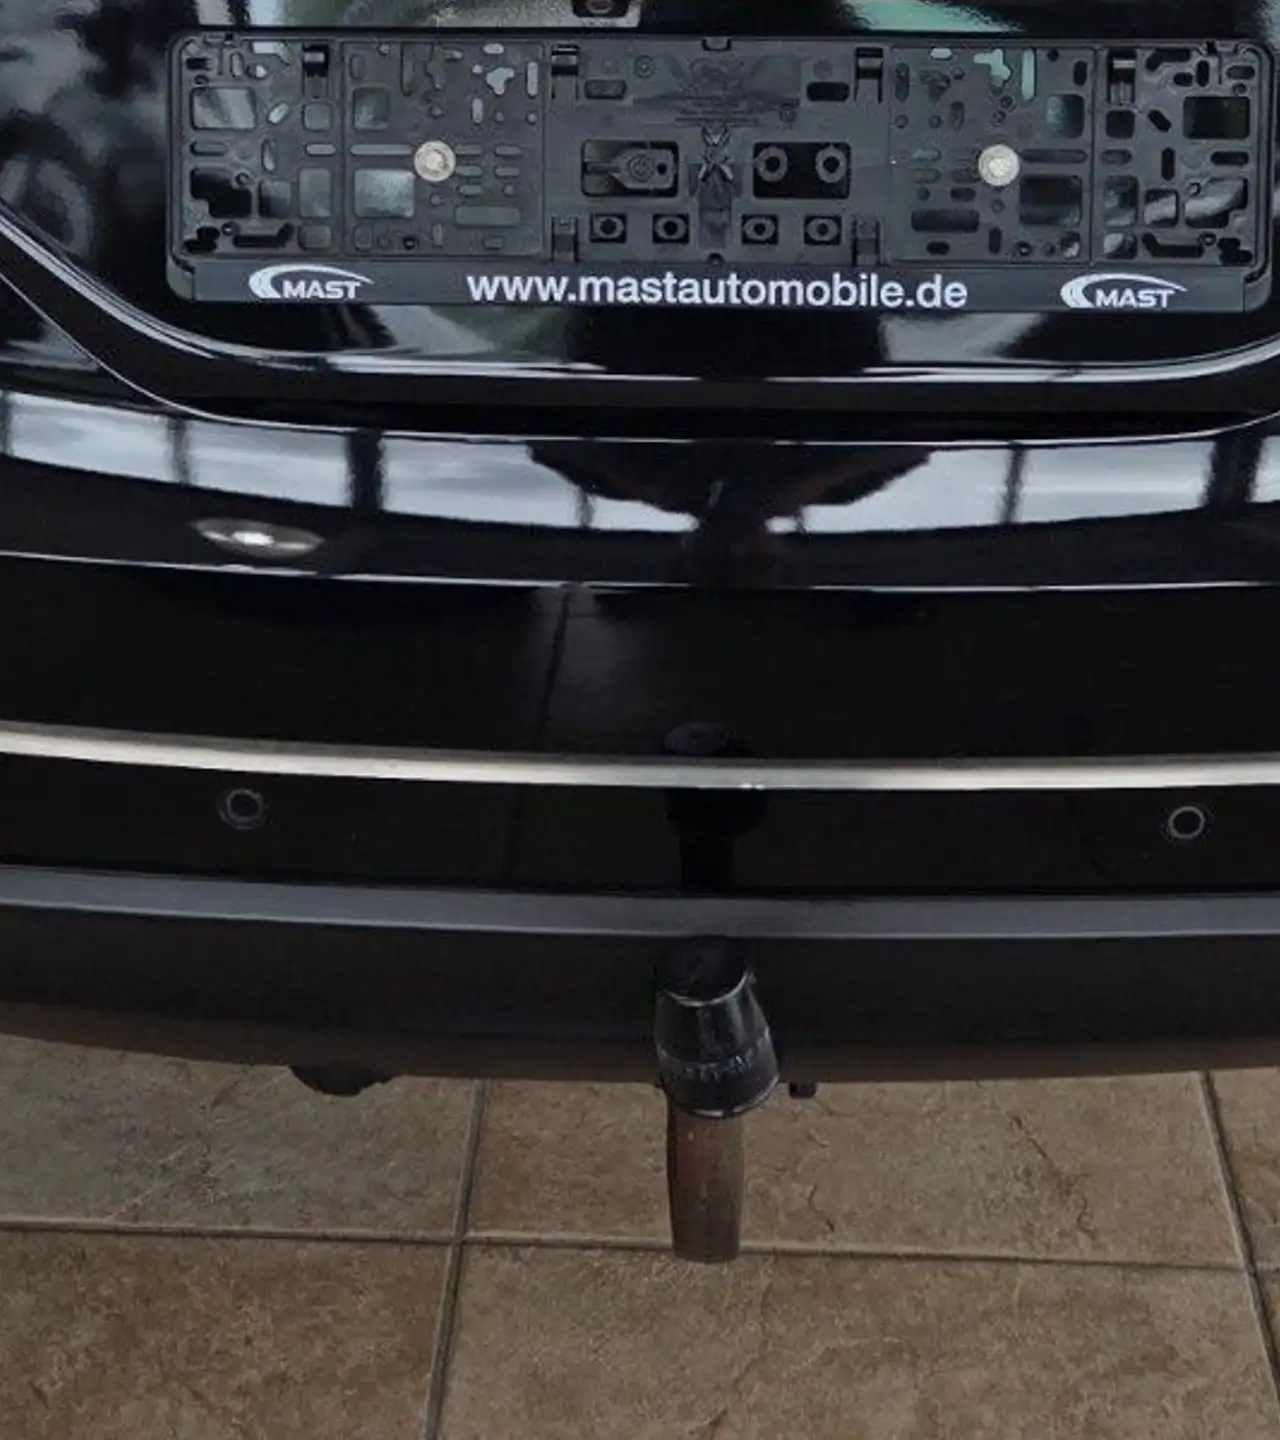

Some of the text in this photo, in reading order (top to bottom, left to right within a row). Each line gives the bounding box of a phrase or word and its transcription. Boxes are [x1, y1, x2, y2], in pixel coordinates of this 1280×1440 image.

[282, 279, 362, 300] MAST
[466, 272, 969, 309] www.mastautomobile.de
[1094, 287, 1176, 309] MAST
